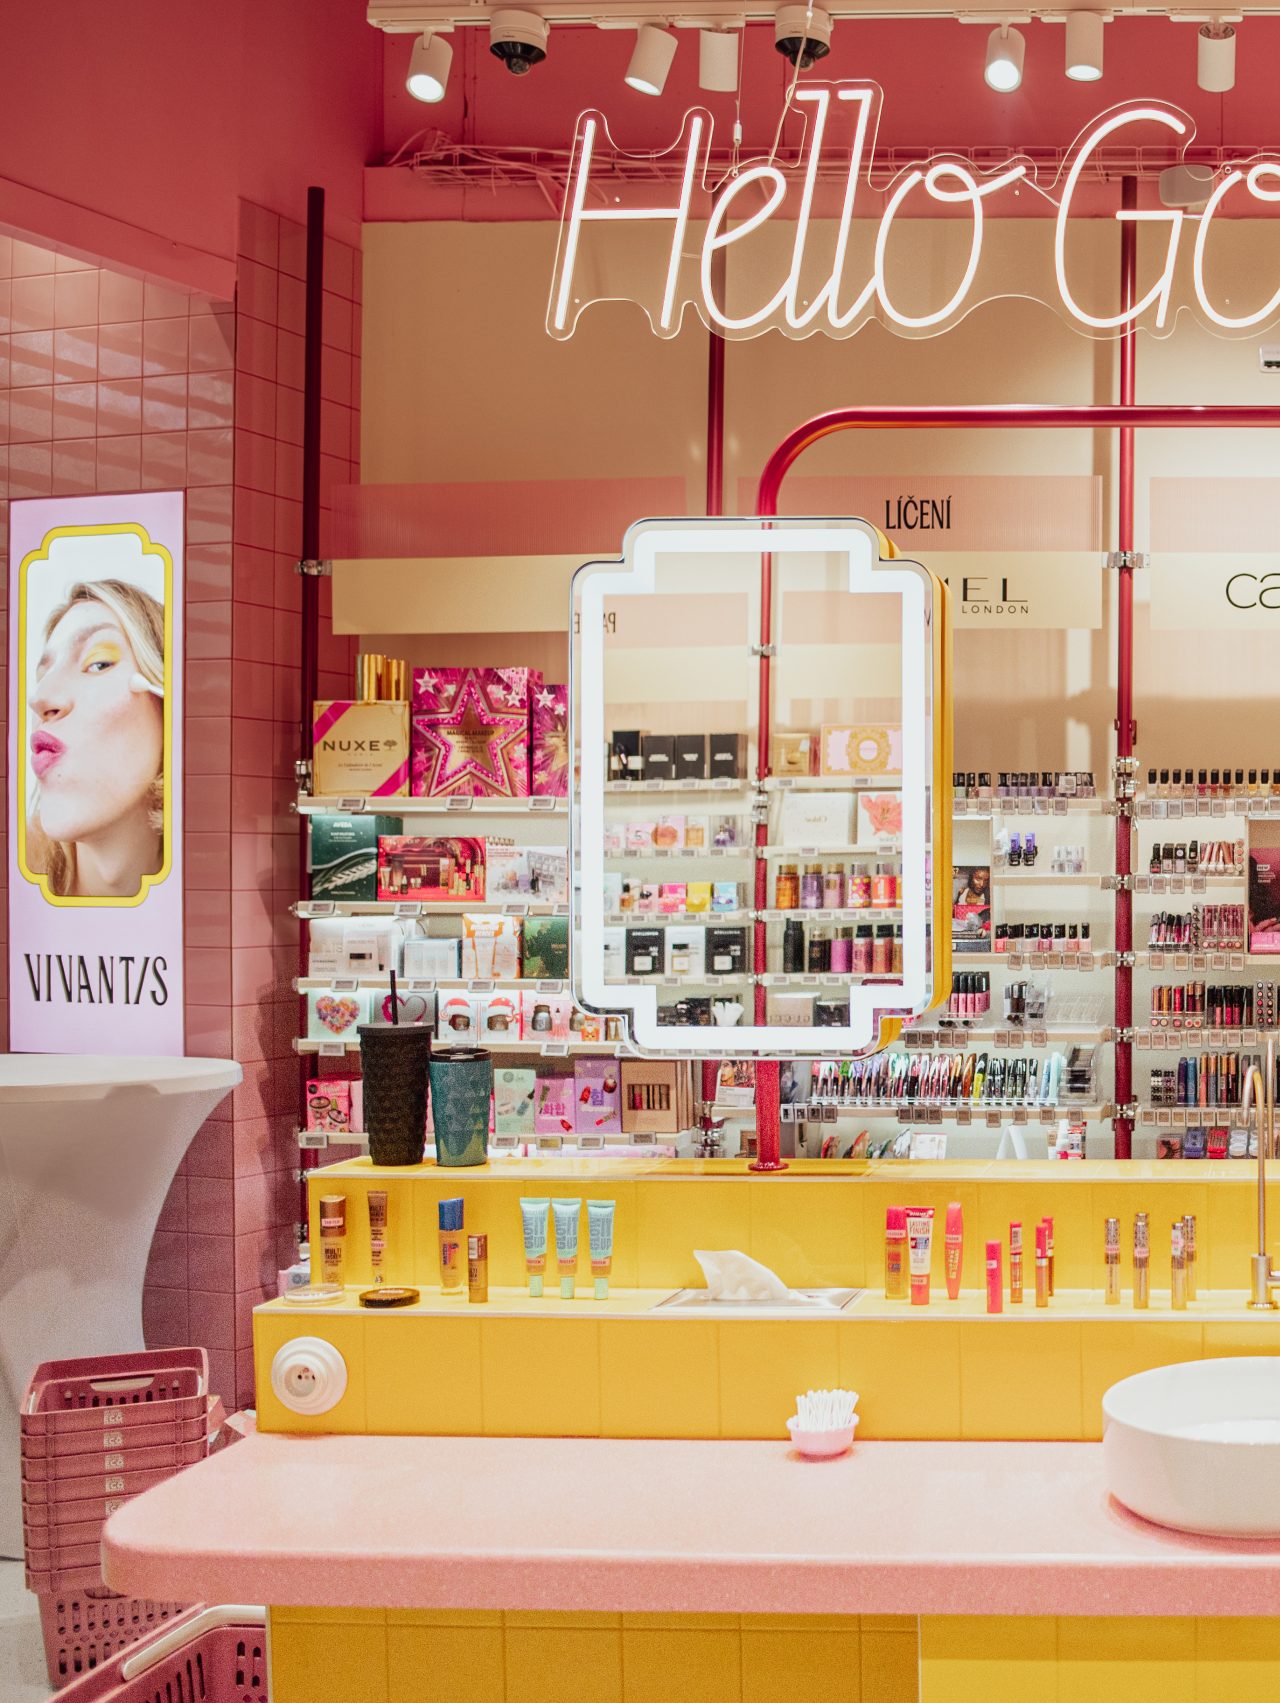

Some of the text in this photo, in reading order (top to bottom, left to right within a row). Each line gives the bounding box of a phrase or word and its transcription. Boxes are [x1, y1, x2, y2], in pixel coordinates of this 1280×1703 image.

[550, 84, 1026, 334] Hello
[885, 494, 952, 530] LÍČENÍ
[961, 605, 1029, 614] LONDON
[322, 740, 381, 751] NUXE
[24, 953, 169, 1006] VIVANT/S
